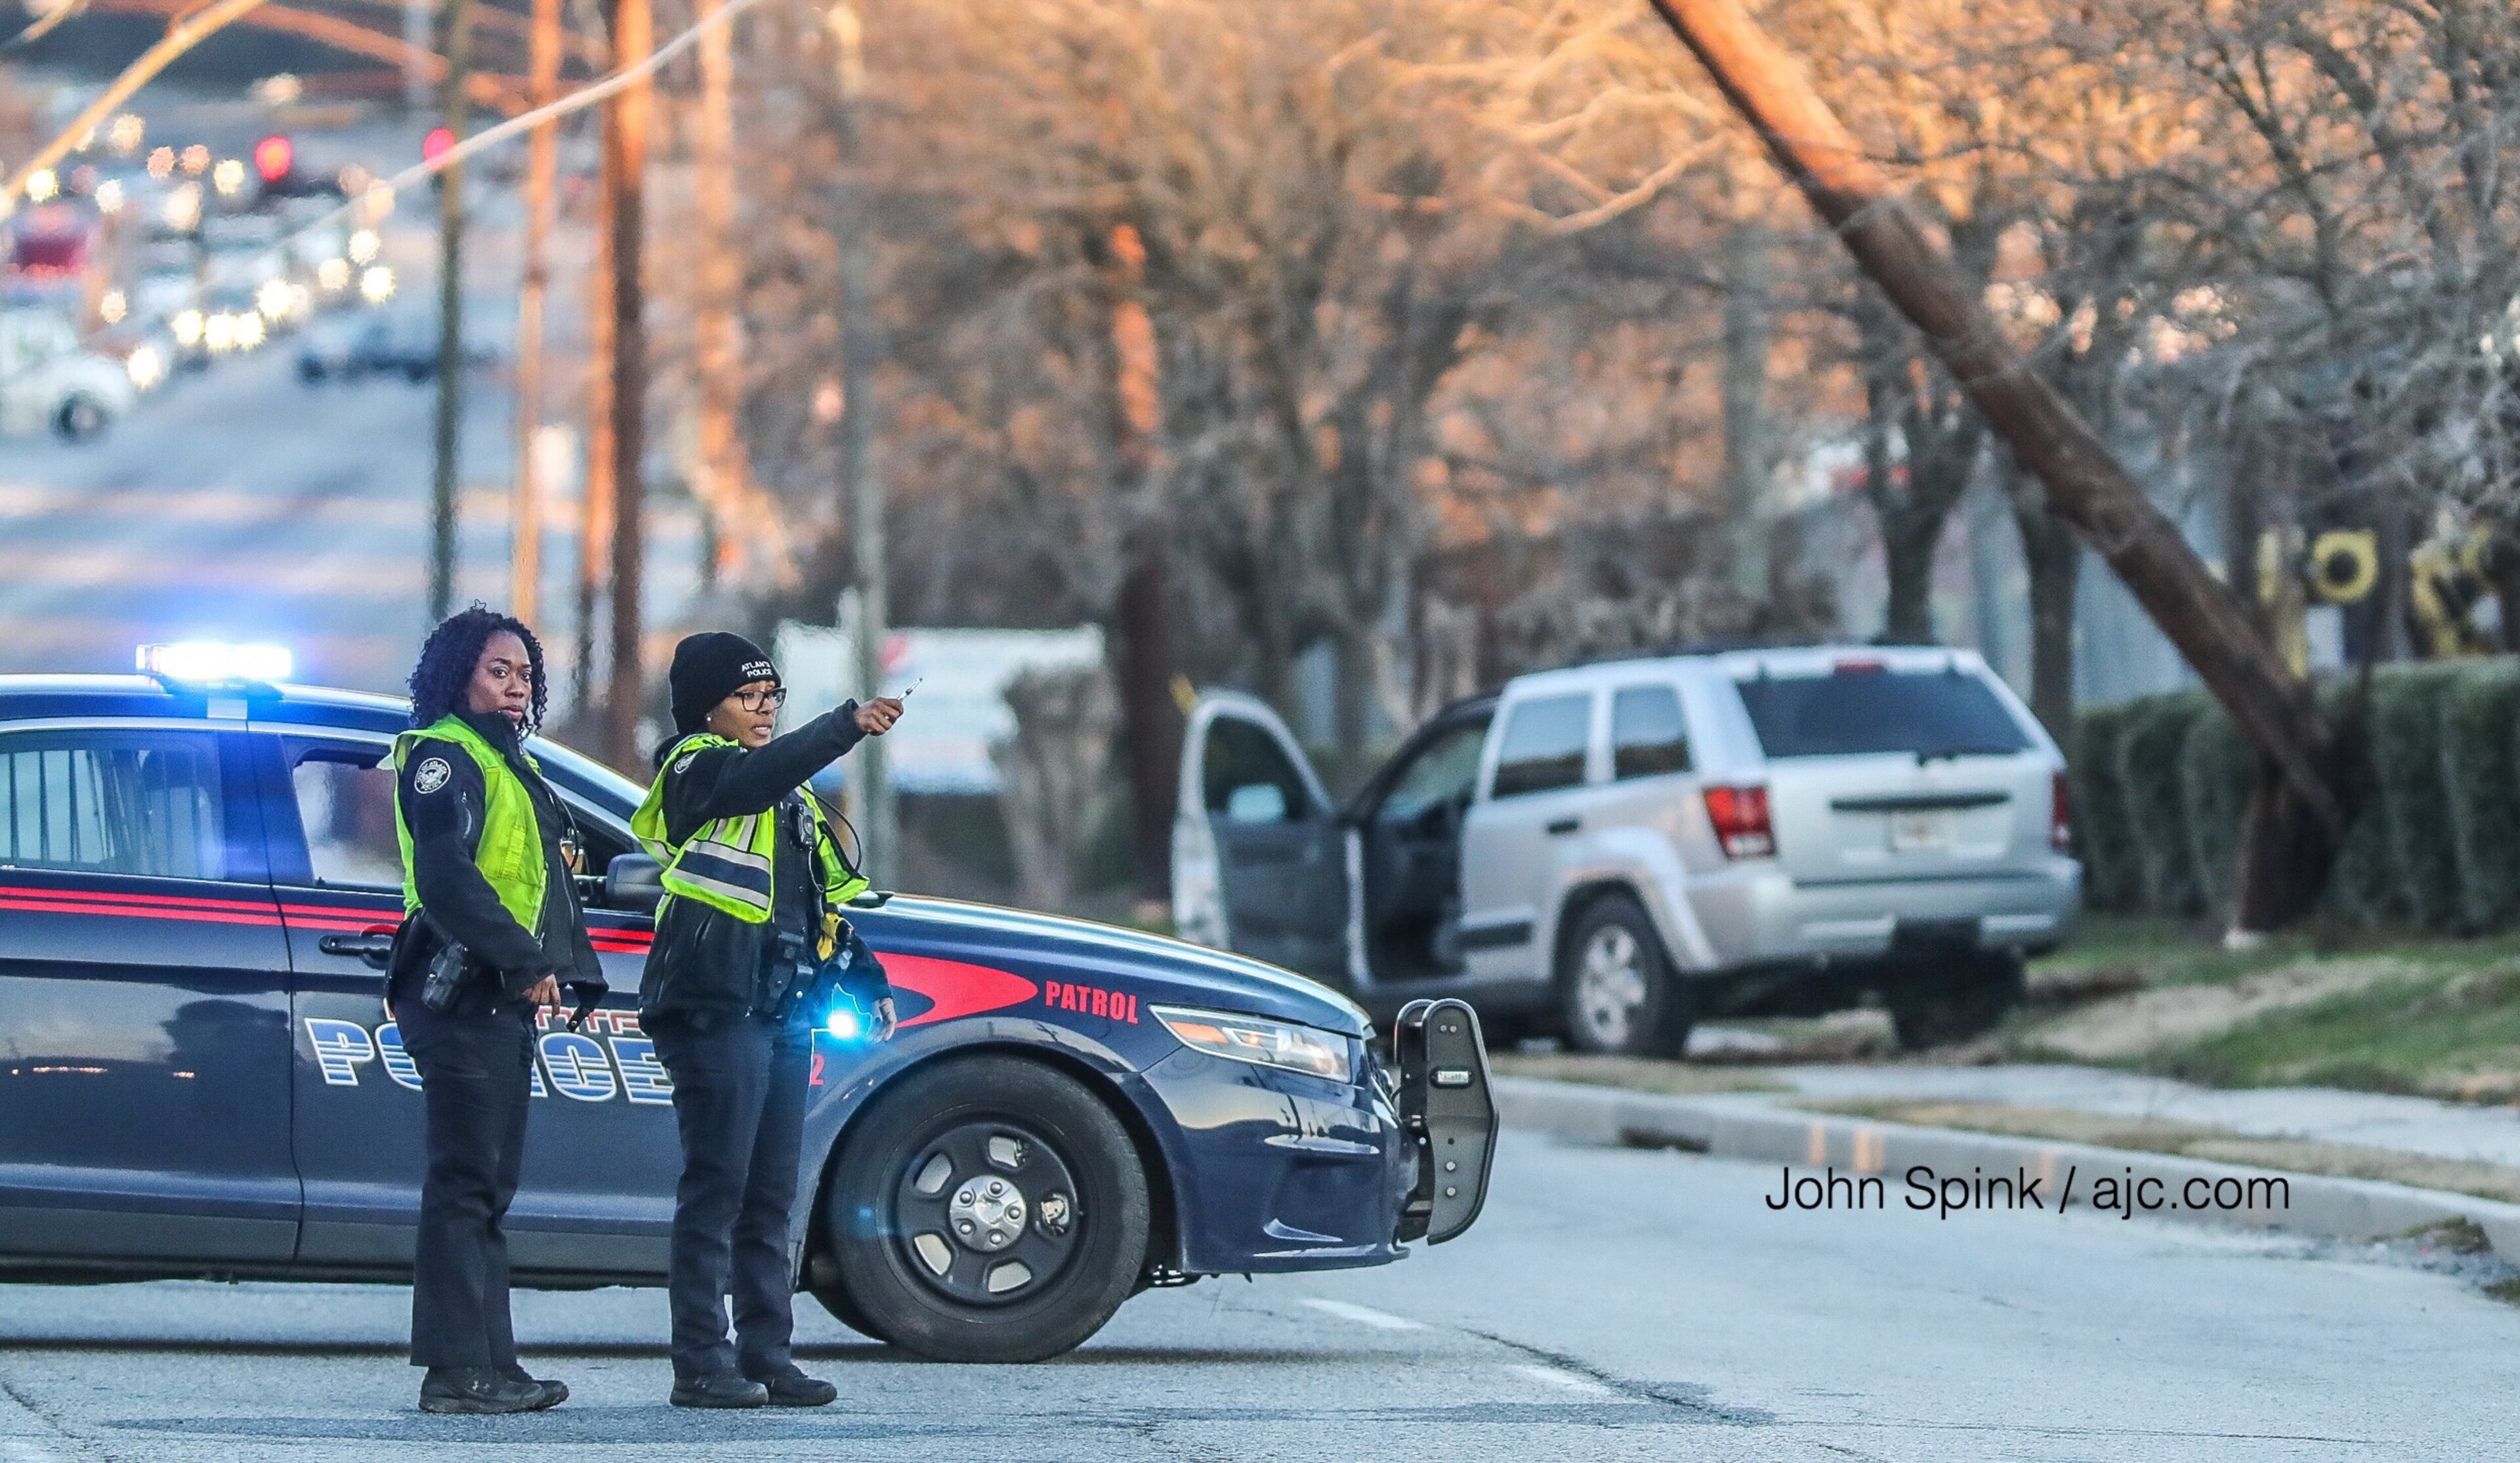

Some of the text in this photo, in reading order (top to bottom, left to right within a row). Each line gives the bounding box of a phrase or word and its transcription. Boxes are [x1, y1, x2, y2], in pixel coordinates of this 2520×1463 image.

[747, 668, 773, 677] POLICE
[1045, 981, 1139, 1024] PATROL
[304, 1017, 676, 1105] POCE
